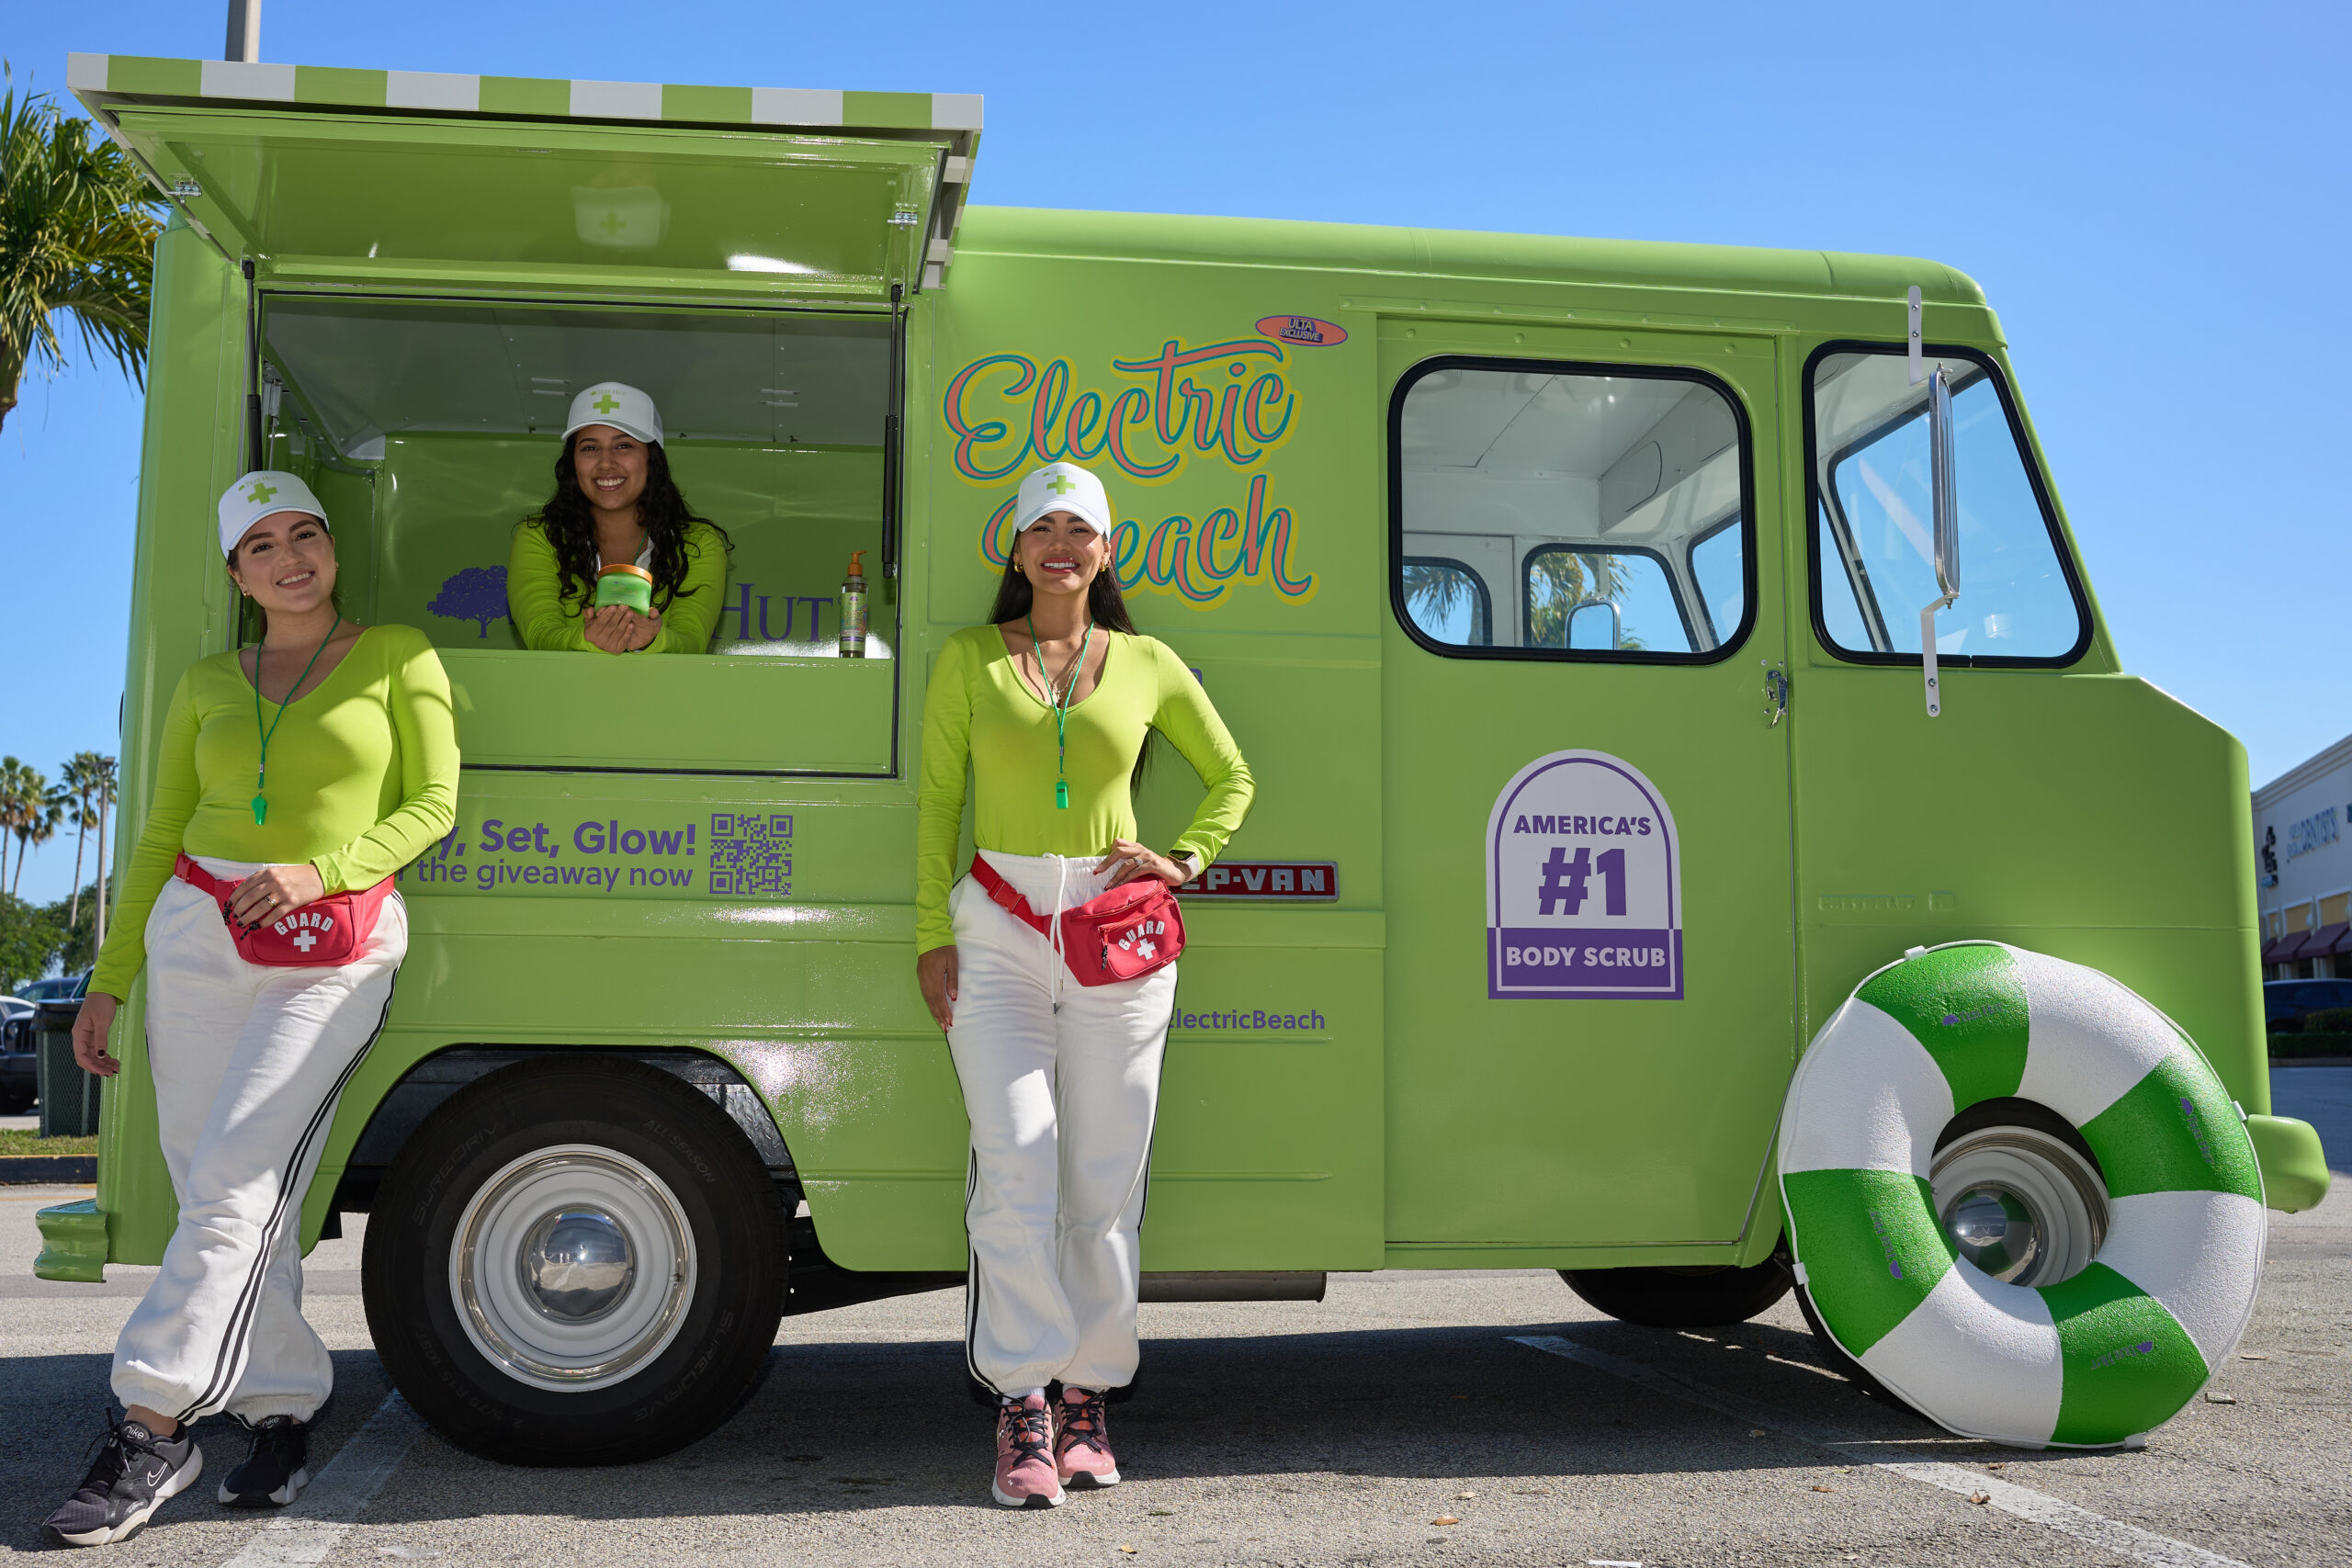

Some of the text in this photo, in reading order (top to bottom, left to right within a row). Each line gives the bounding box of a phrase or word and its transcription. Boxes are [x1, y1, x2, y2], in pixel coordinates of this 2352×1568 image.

[1279, 328, 1320, 341] EXCLUSIVE
[1288, 318, 1313, 331] ULTA
[943, 339, 1295, 480] Electric
[479, 818, 560, 857] Set,
[573, 820, 696, 856] Glow!
[1513, 815, 1652, 836] AMERICA'S
[417, 856, 468, 883] the
[477, 858, 620, 893] giveaway
[629, 867, 694, 887] now
[1538, 847, 1627, 916] #1
[274, 912, 334, 936] GUARD
[1118, 920, 1166, 951] GUARD
[1506, 947, 1667, 967] BODY SCRUB
[643, 1117, 718, 1186] ALL-SEASON
[124, 1426, 144, 1439] nike
